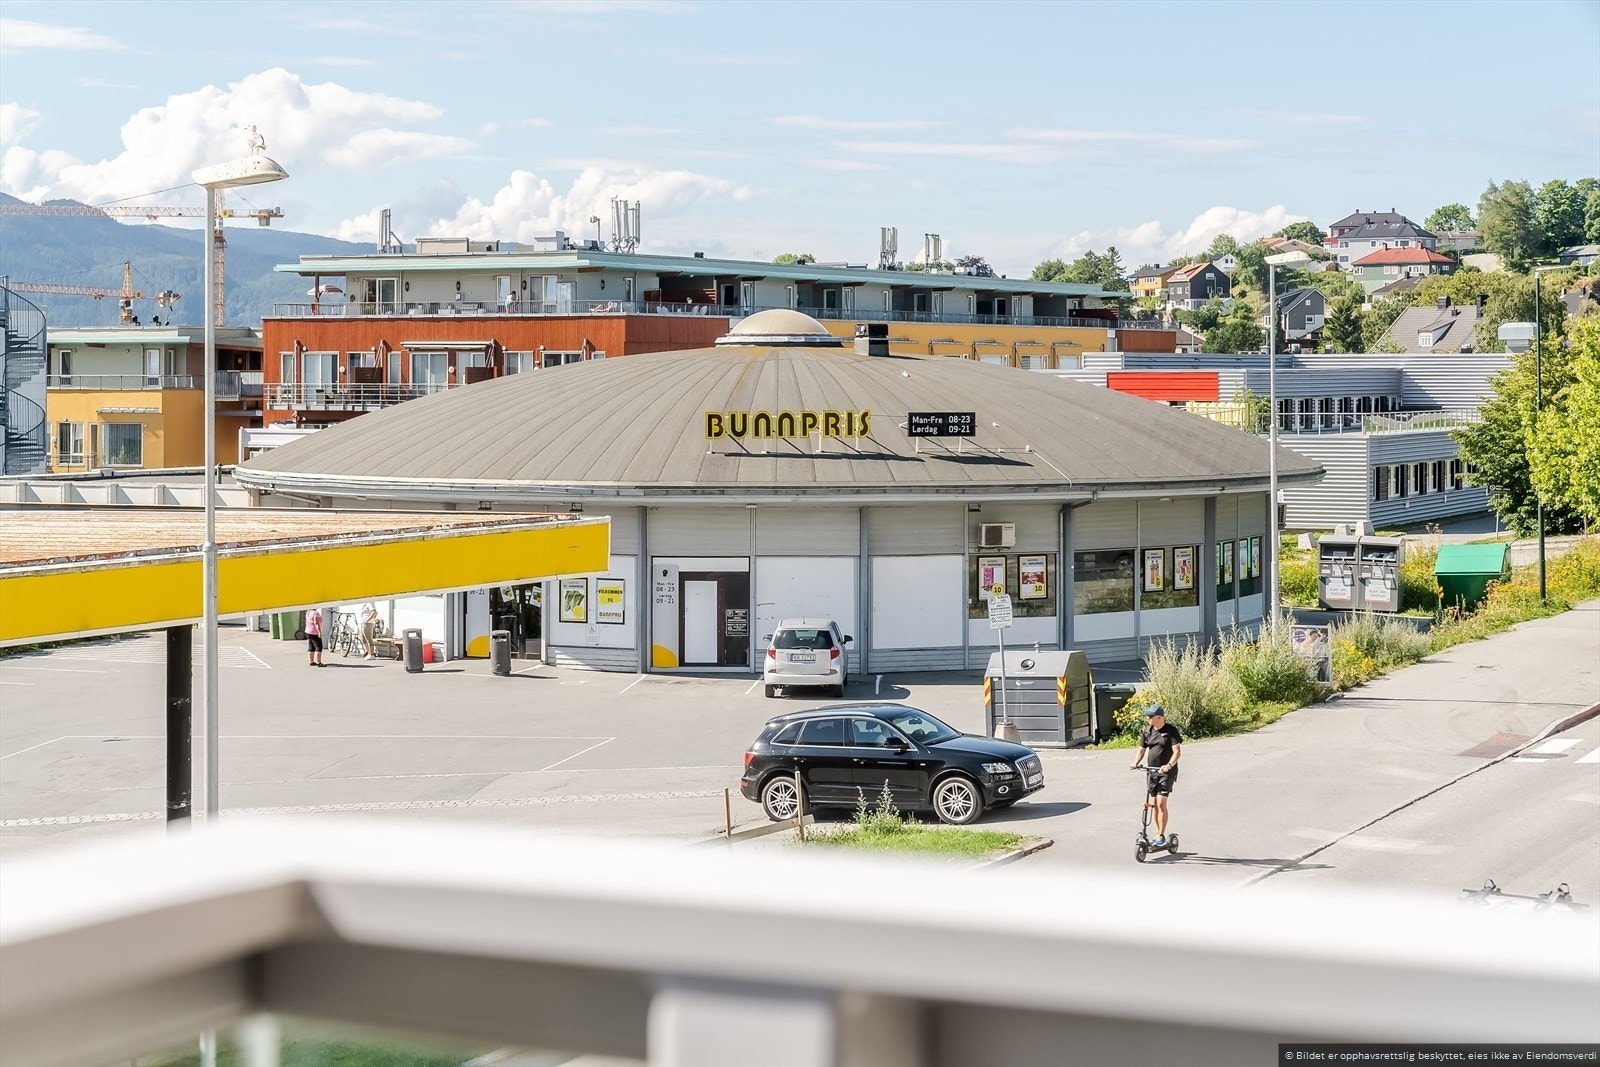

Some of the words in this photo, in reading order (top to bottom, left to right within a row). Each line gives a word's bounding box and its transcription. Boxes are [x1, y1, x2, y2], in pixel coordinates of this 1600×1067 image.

[706, 410, 871, 439] BUNNPRIS
[912, 416, 943, 424] Man-Fre
[948, 415, 971, 424] 08-23
[912, 425, 938, 435] Lørdag
[948, 425, 971, 433] 09-21
